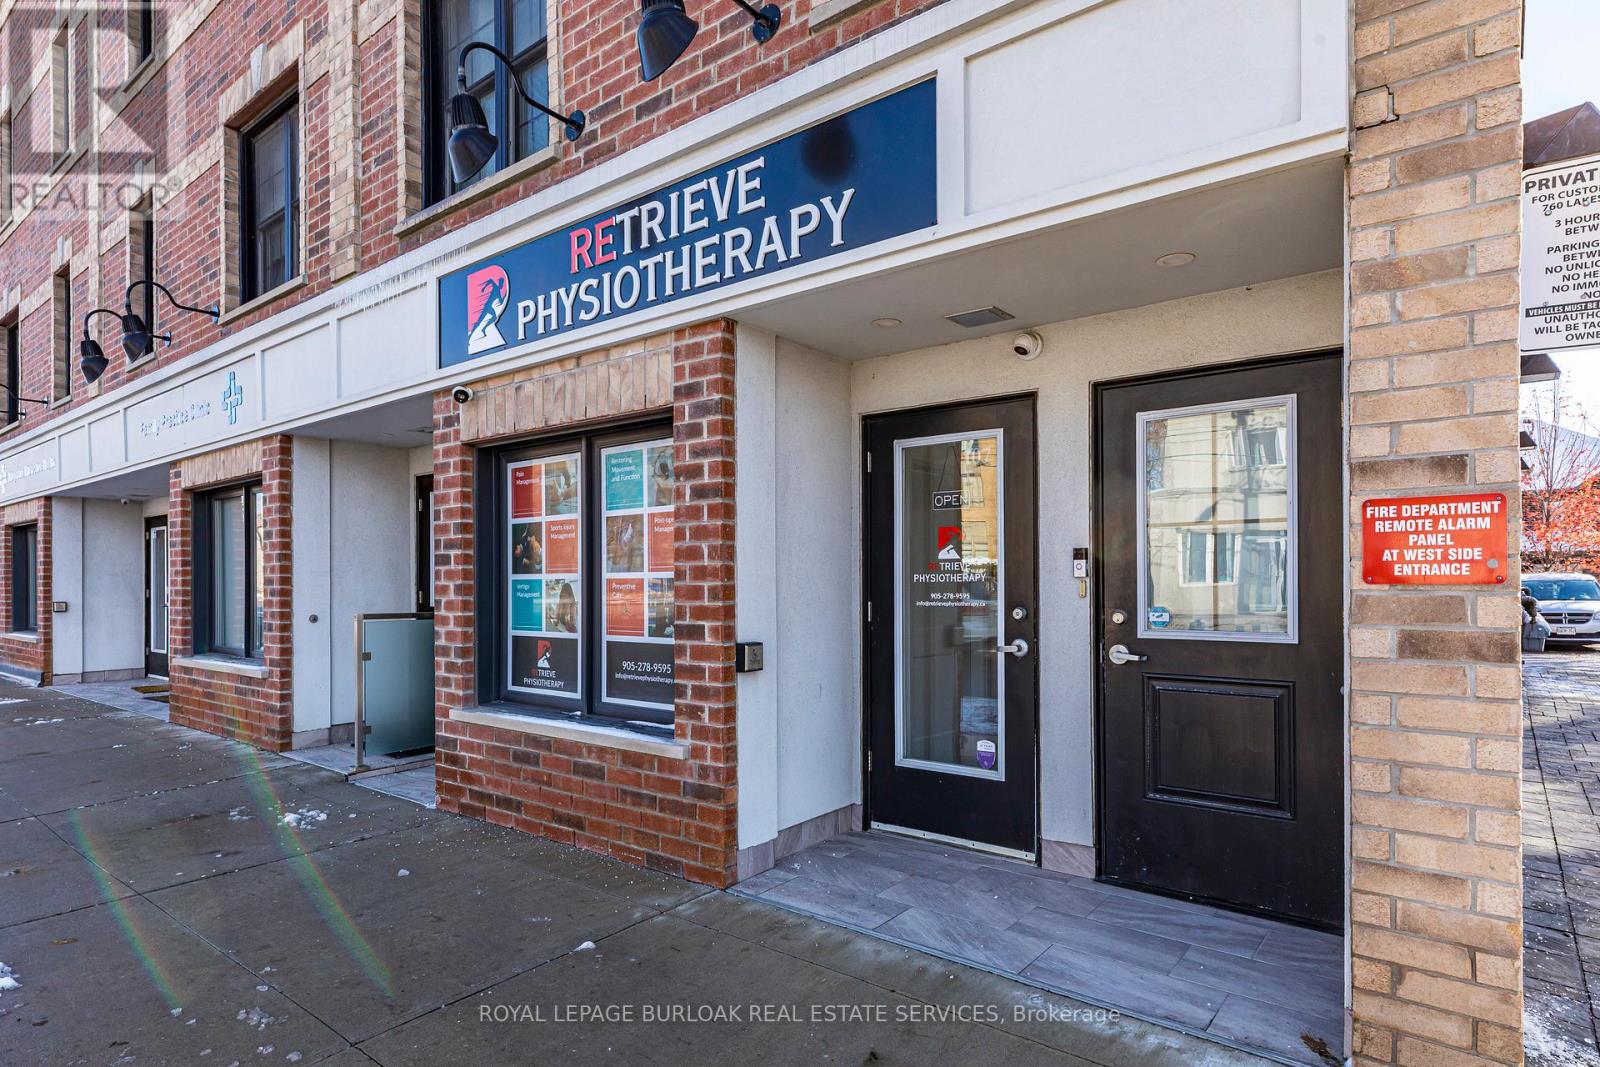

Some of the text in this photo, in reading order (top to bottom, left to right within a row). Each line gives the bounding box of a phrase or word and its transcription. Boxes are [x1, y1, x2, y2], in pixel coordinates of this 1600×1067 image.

[1532, 185, 1600, 204] FOR CUSTO
[1542, 202, 1564, 213] 760
[570, 156, 766, 275] RETRIEVE
[1555, 213, 1600, 228] 3 HOUR
[1547, 239, 1600, 255] PARKING
[516, 188, 856, 341] PHYSIOTHERAPY
[1545, 265, 1563, 275] NO
[1562, 270, 1600, 282] NO HE
[1552, 280, 1600, 294] NO IMM
[1529, 301, 1598, 317] VEHICLES MUST BE
[1534, 325, 1562, 335] WILL
[1565, 322, 1580, 332] BE
[611, 465, 635, 473] Movement
[611, 473, 640, 482] and Function
[934, 494, 968, 507] OPEN
[1366, 500, 1501, 518] FIRE DEPARTMENT
[1375, 517, 1491, 533] REMOTE ALARM
[550, 532, 576, 540] Management
[1408, 533, 1454, 546] PANEL
[1382, 547, 1482, 562] AT WEST SIDE
[1394, 562, 1470, 576] ENTRANCE
[913, 573, 986, 583] PHYSIOTHERAPY
[612, 583, 636, 591] Preventive
[516, 591, 541, 599] Management
[930, 592, 970, 600] 905-278-9595
[622, 660, 672, 674] 905-278-9595
[523, 677, 565, 689] PHYSIOTHERAPY
